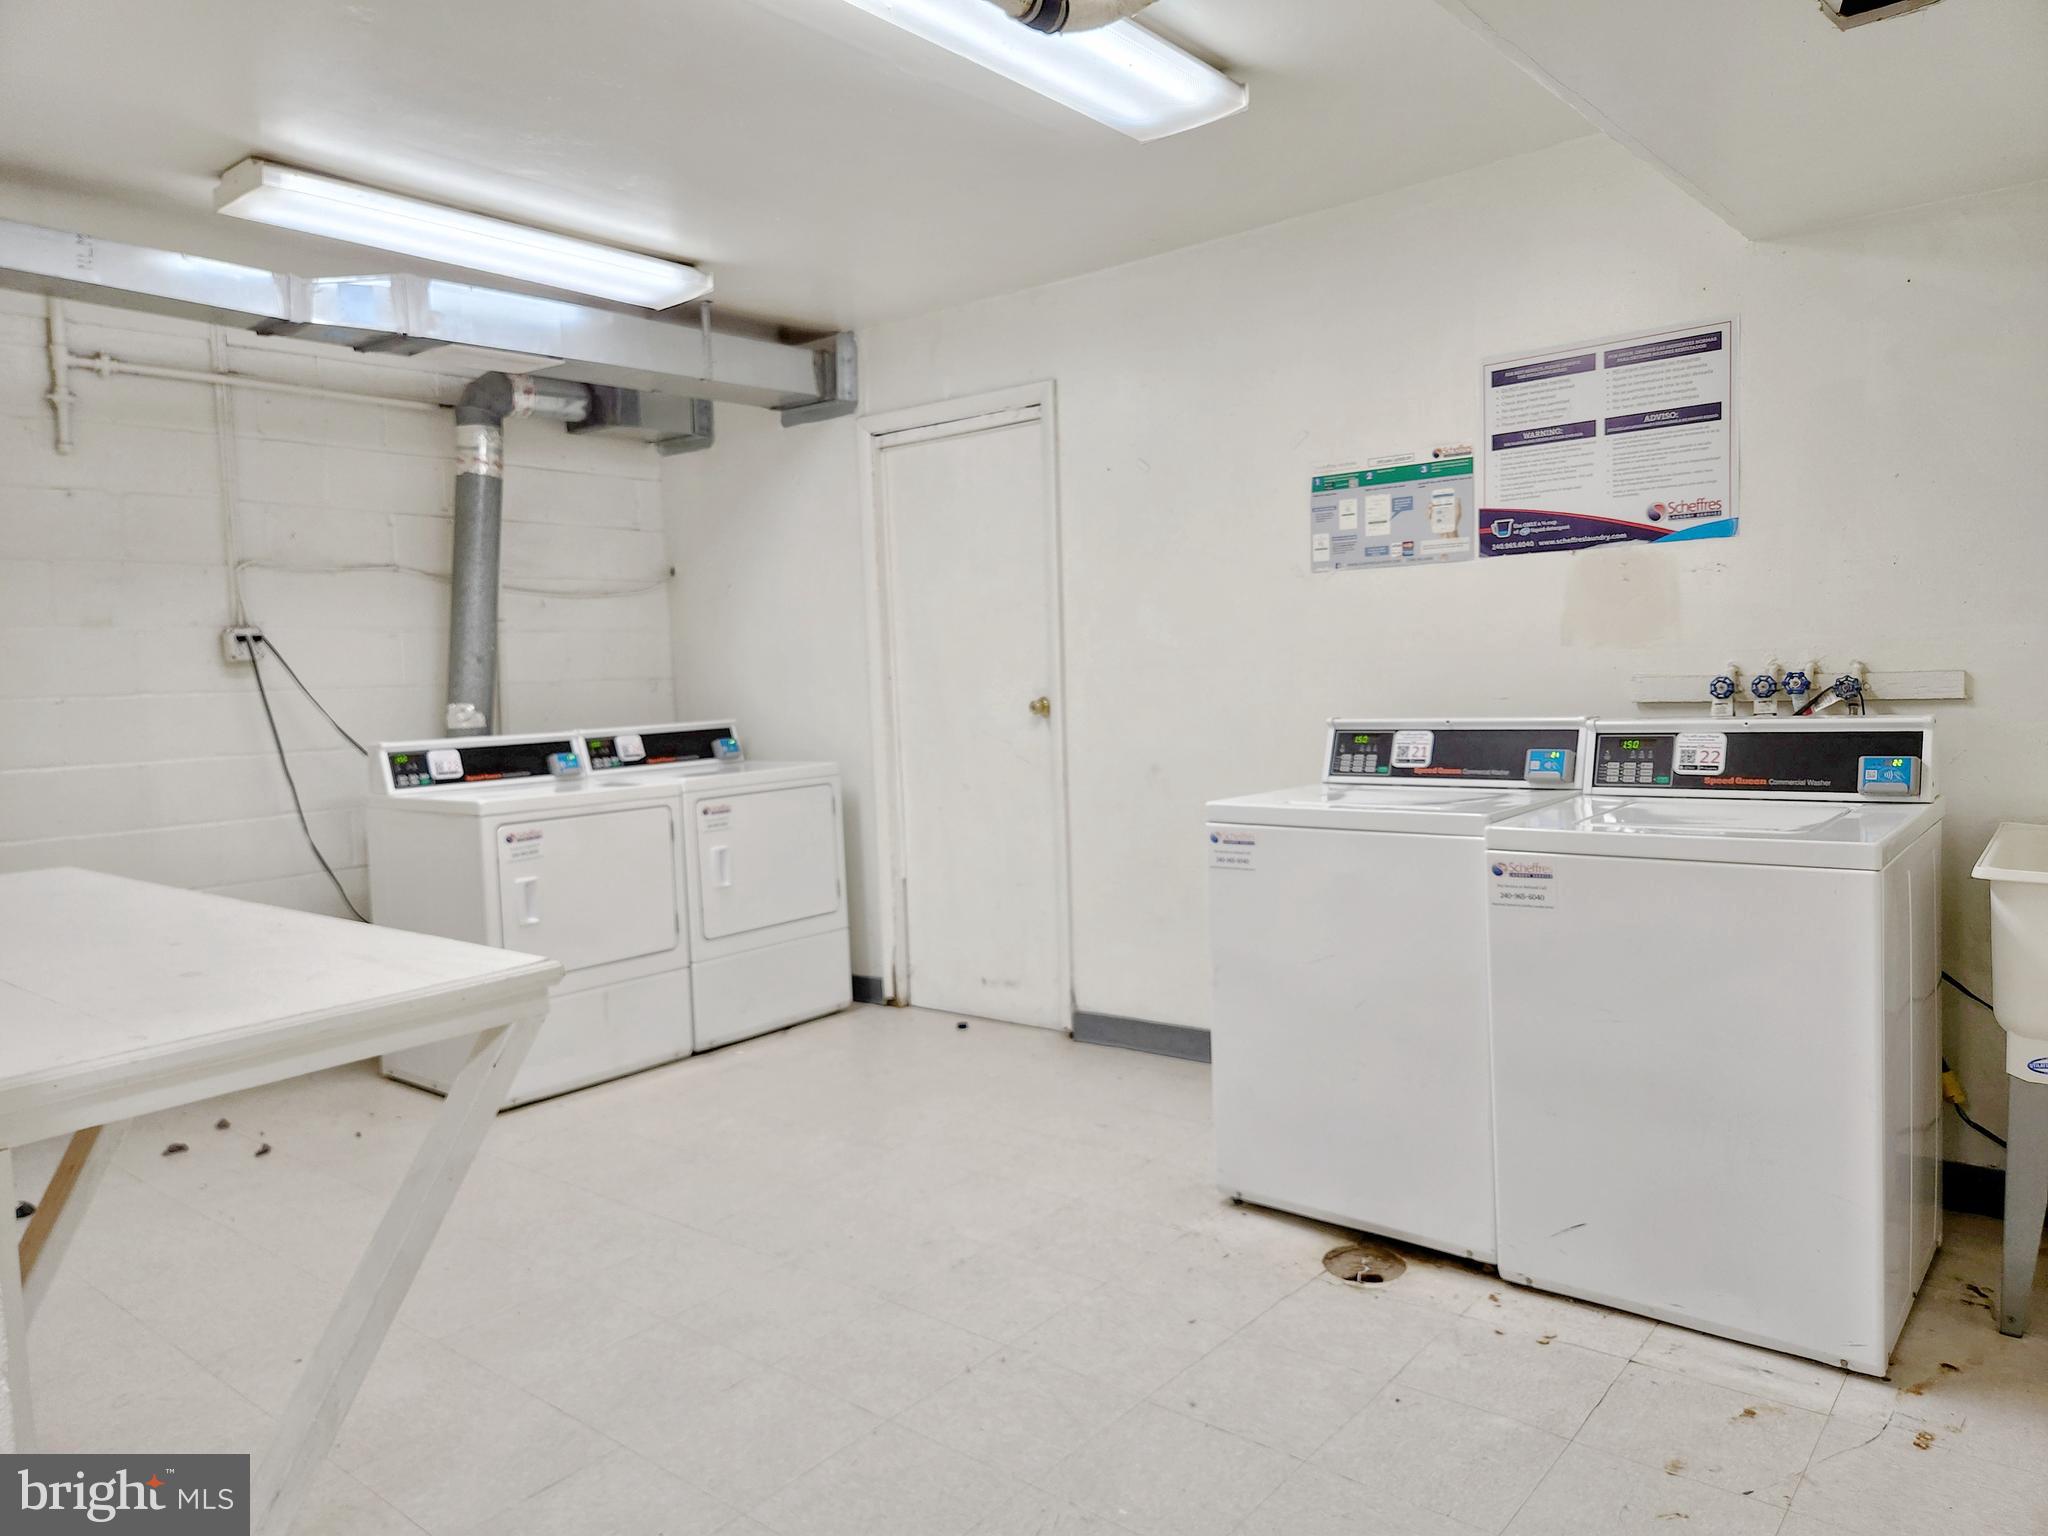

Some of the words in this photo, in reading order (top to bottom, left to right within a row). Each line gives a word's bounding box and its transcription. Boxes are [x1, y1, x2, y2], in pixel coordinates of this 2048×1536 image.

[1643, 411, 1679, 423] ADVISO:
[1522, 427, 1563, 439] WARNING:
[1668, 497, 1722, 514] Scheffres
[1411, 745, 1427, 758] 21
[1699, 750, 1721, 764] 22
[1704, 776, 1734, 786] Speed
[1735, 777, 1767, 785] Queen
[1768, 778, 1806, 786] Commercial
[1807, 779, 1832, 787] Washer
